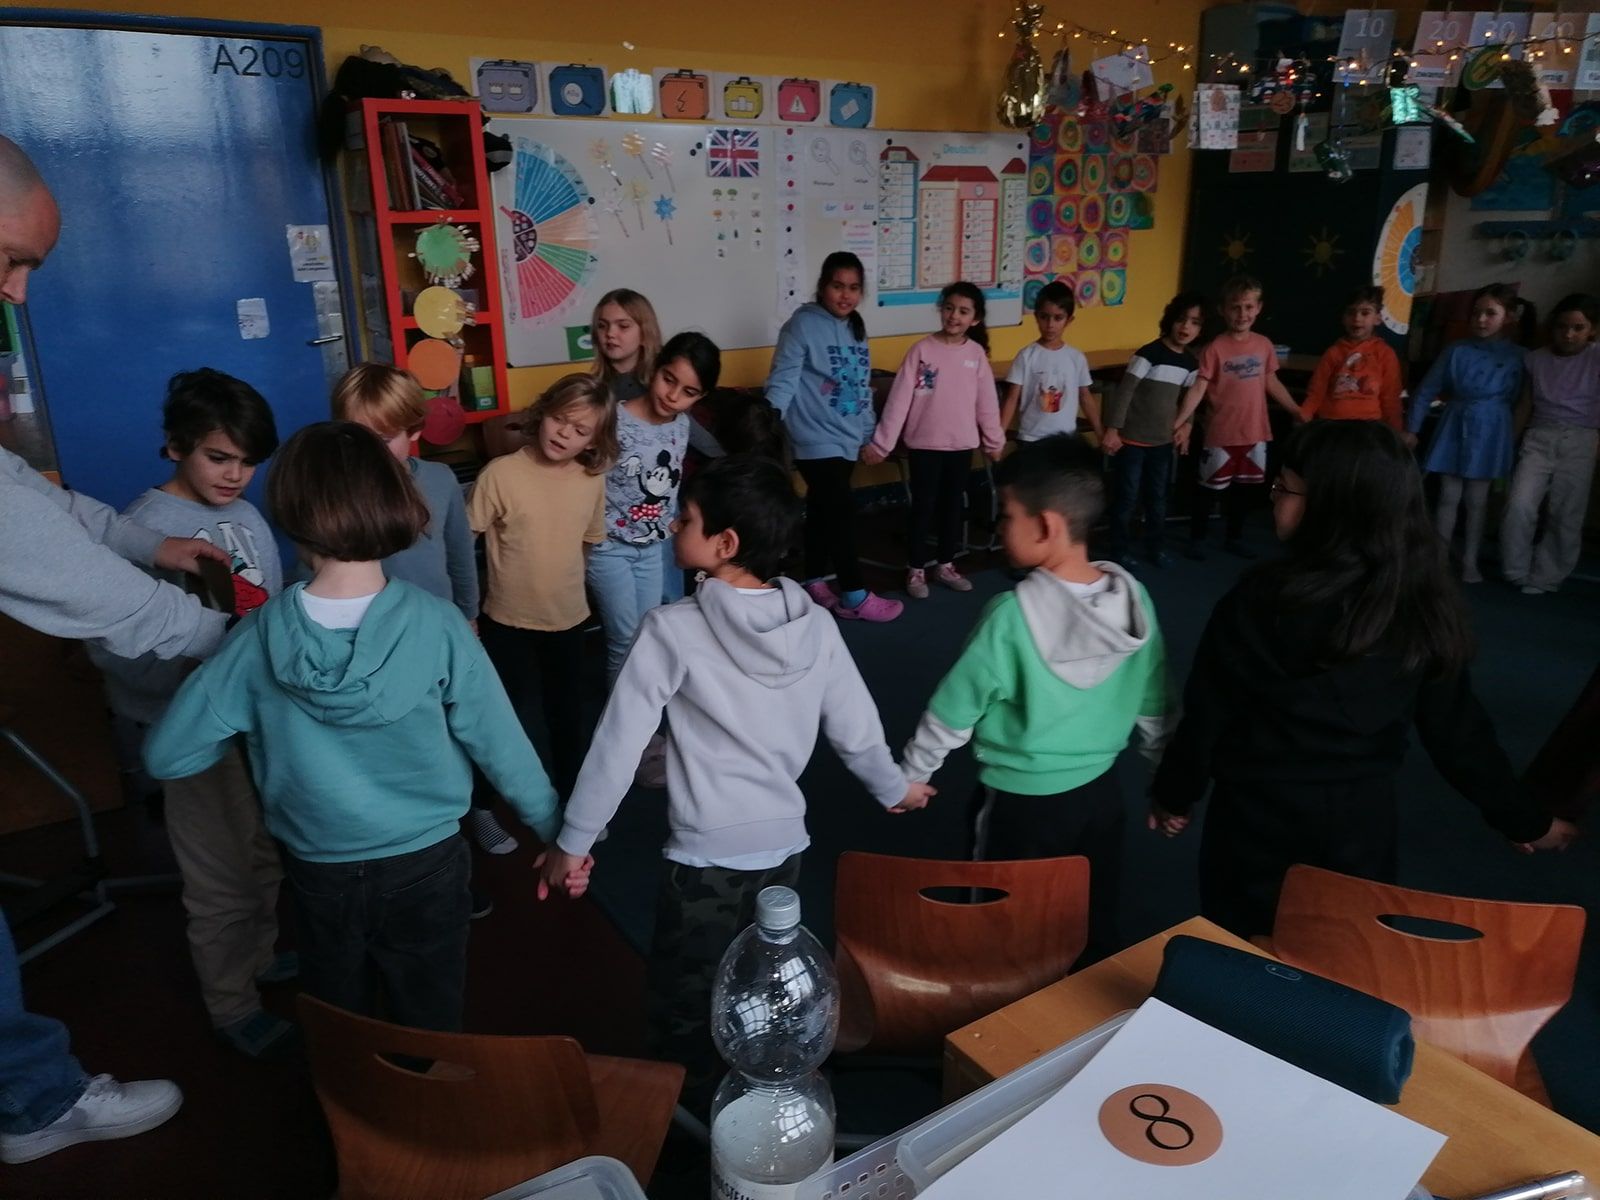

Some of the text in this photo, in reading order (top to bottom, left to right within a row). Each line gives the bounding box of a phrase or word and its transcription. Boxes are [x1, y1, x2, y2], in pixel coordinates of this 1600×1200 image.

[1355, 17, 1385, 38] 10
[1428, 20, 1461, 40] 20
[212, 43, 305, 79] A209
[1129, 1094, 1194, 1151] 8
